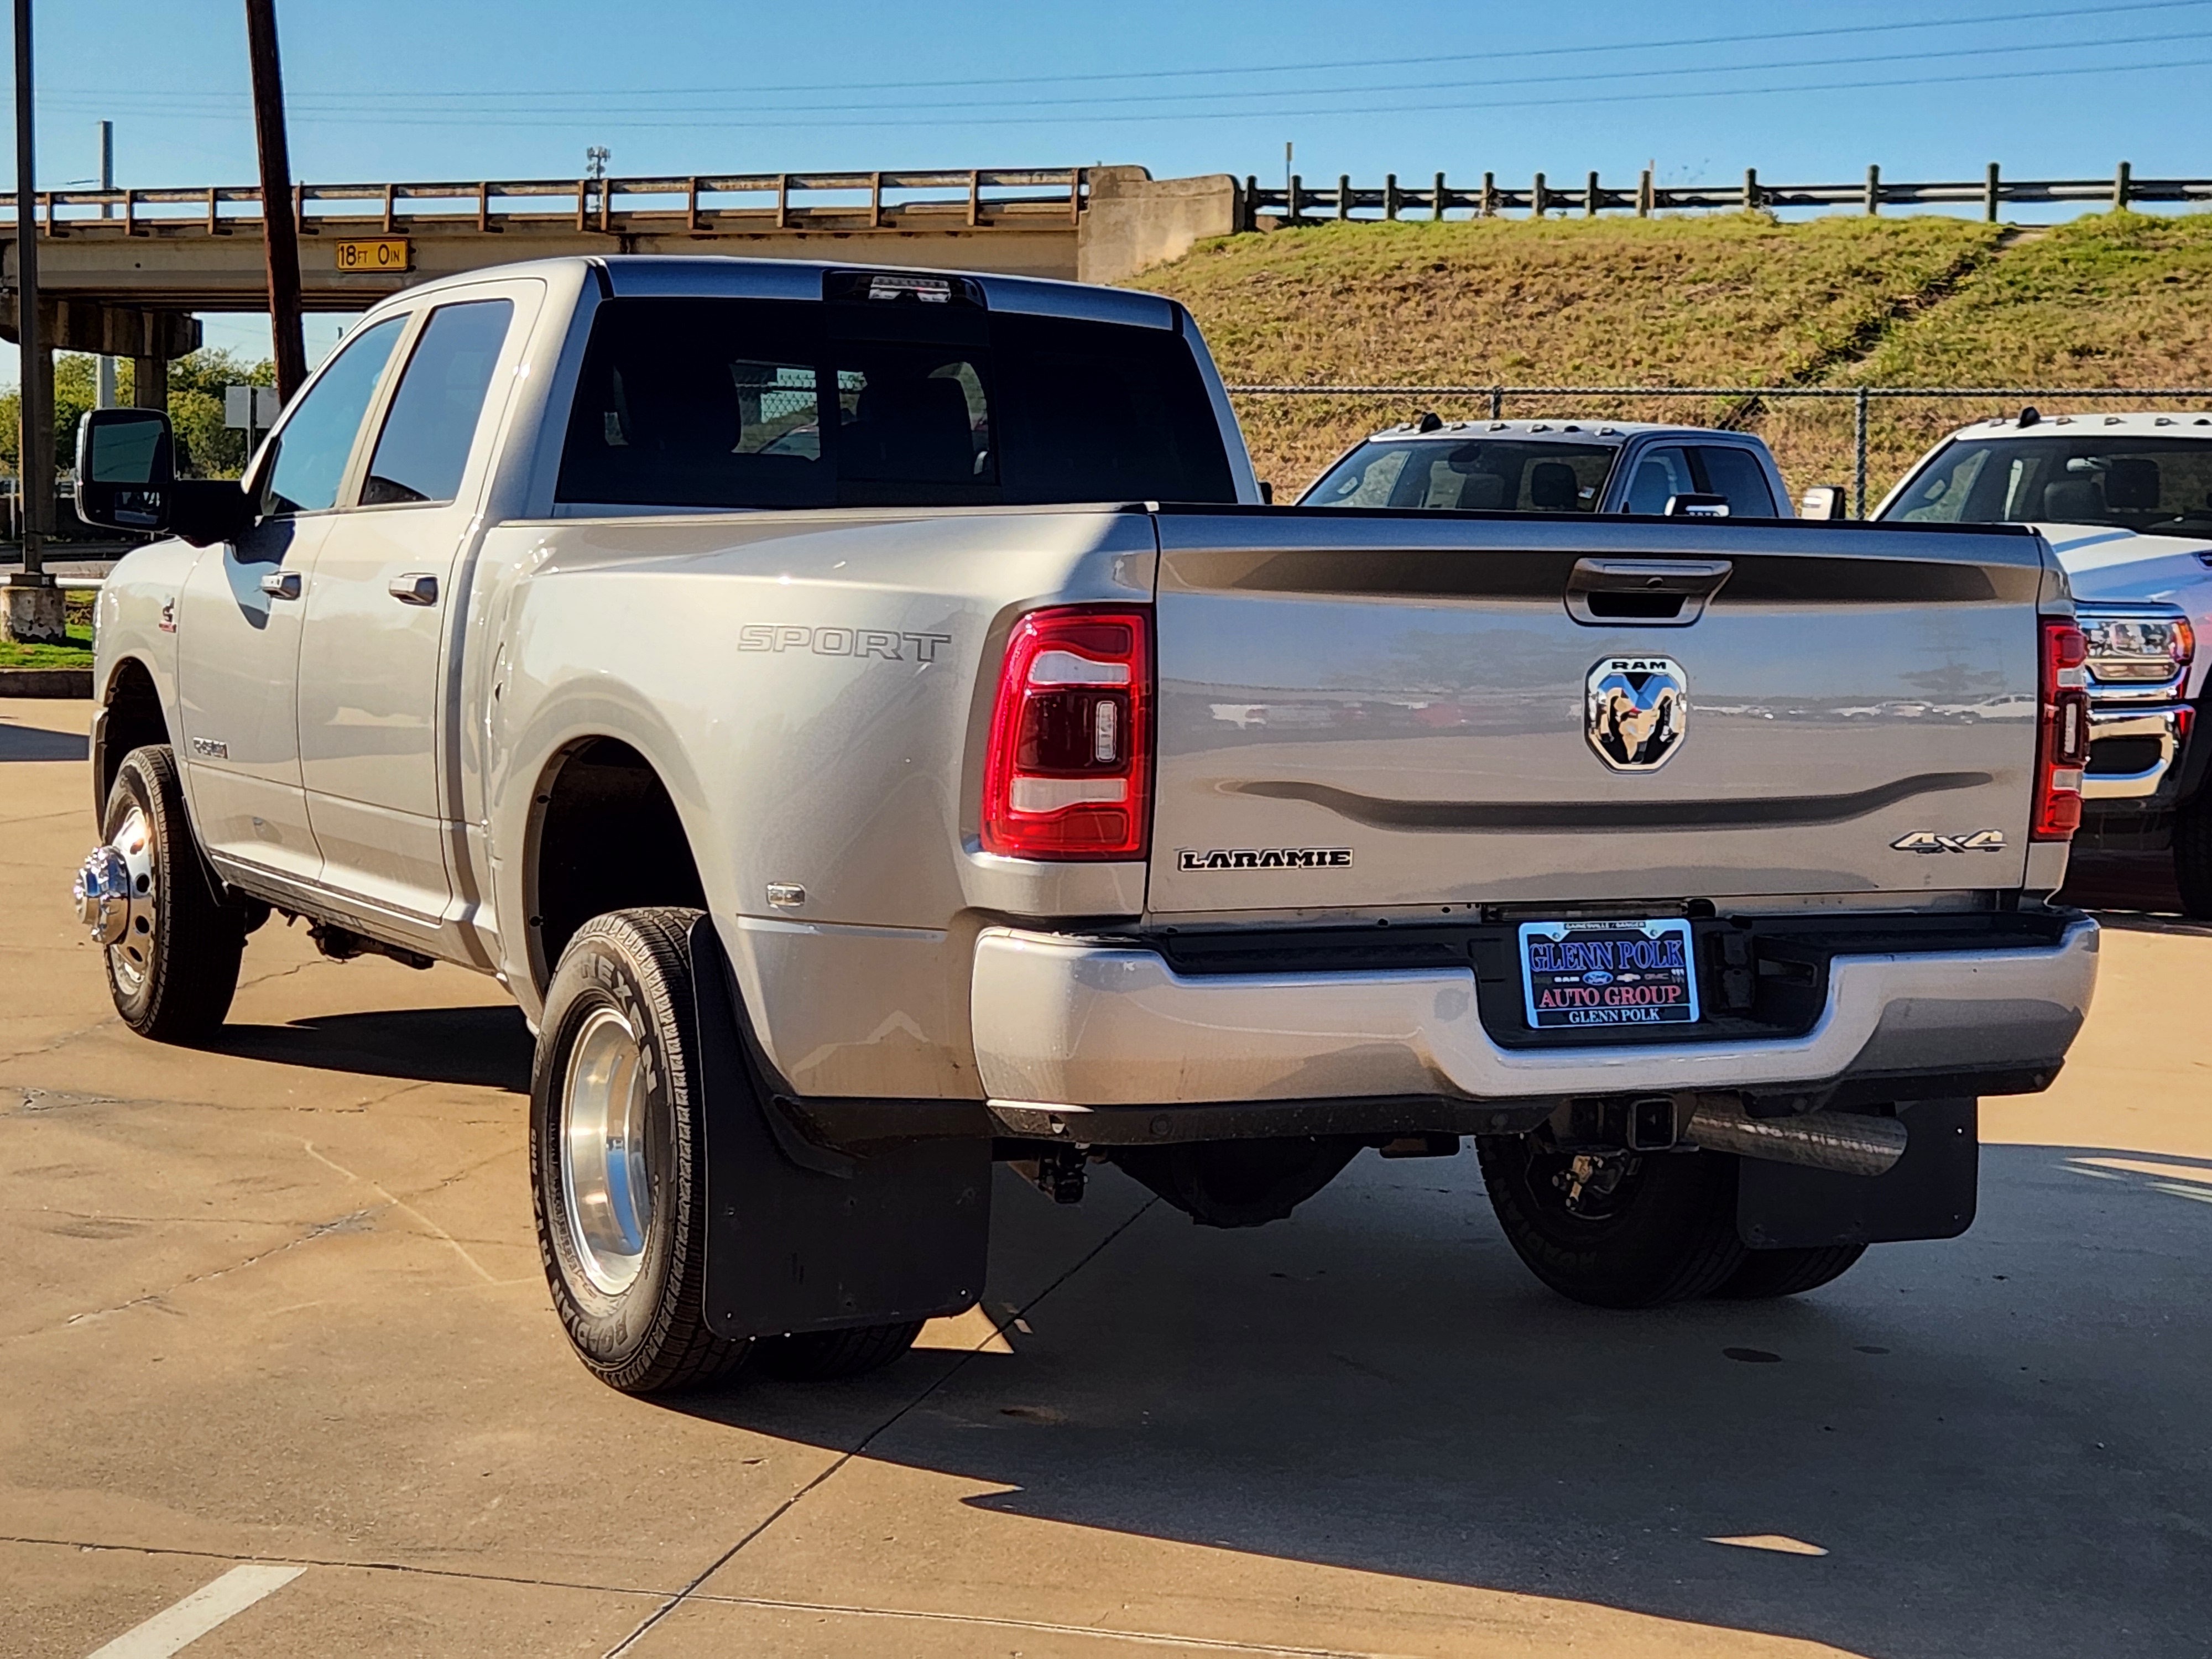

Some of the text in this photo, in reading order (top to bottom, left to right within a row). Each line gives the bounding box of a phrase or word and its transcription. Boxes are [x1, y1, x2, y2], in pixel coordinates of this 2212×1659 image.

[738, 624, 952, 662] SPORT
[1611, 661, 1666, 670] RAM
[1179, 848, 1354, 870] LARAMIE
[1530, 940, 1685, 972] GLENN POLK
[1539, 985, 1682, 1008] AUTO GROUP
[582, 952, 657, 1095] NEXEN
[1568, 1008, 1660, 1024] GLENN POLK
[551, 1278, 628, 1353] ROADIAN
